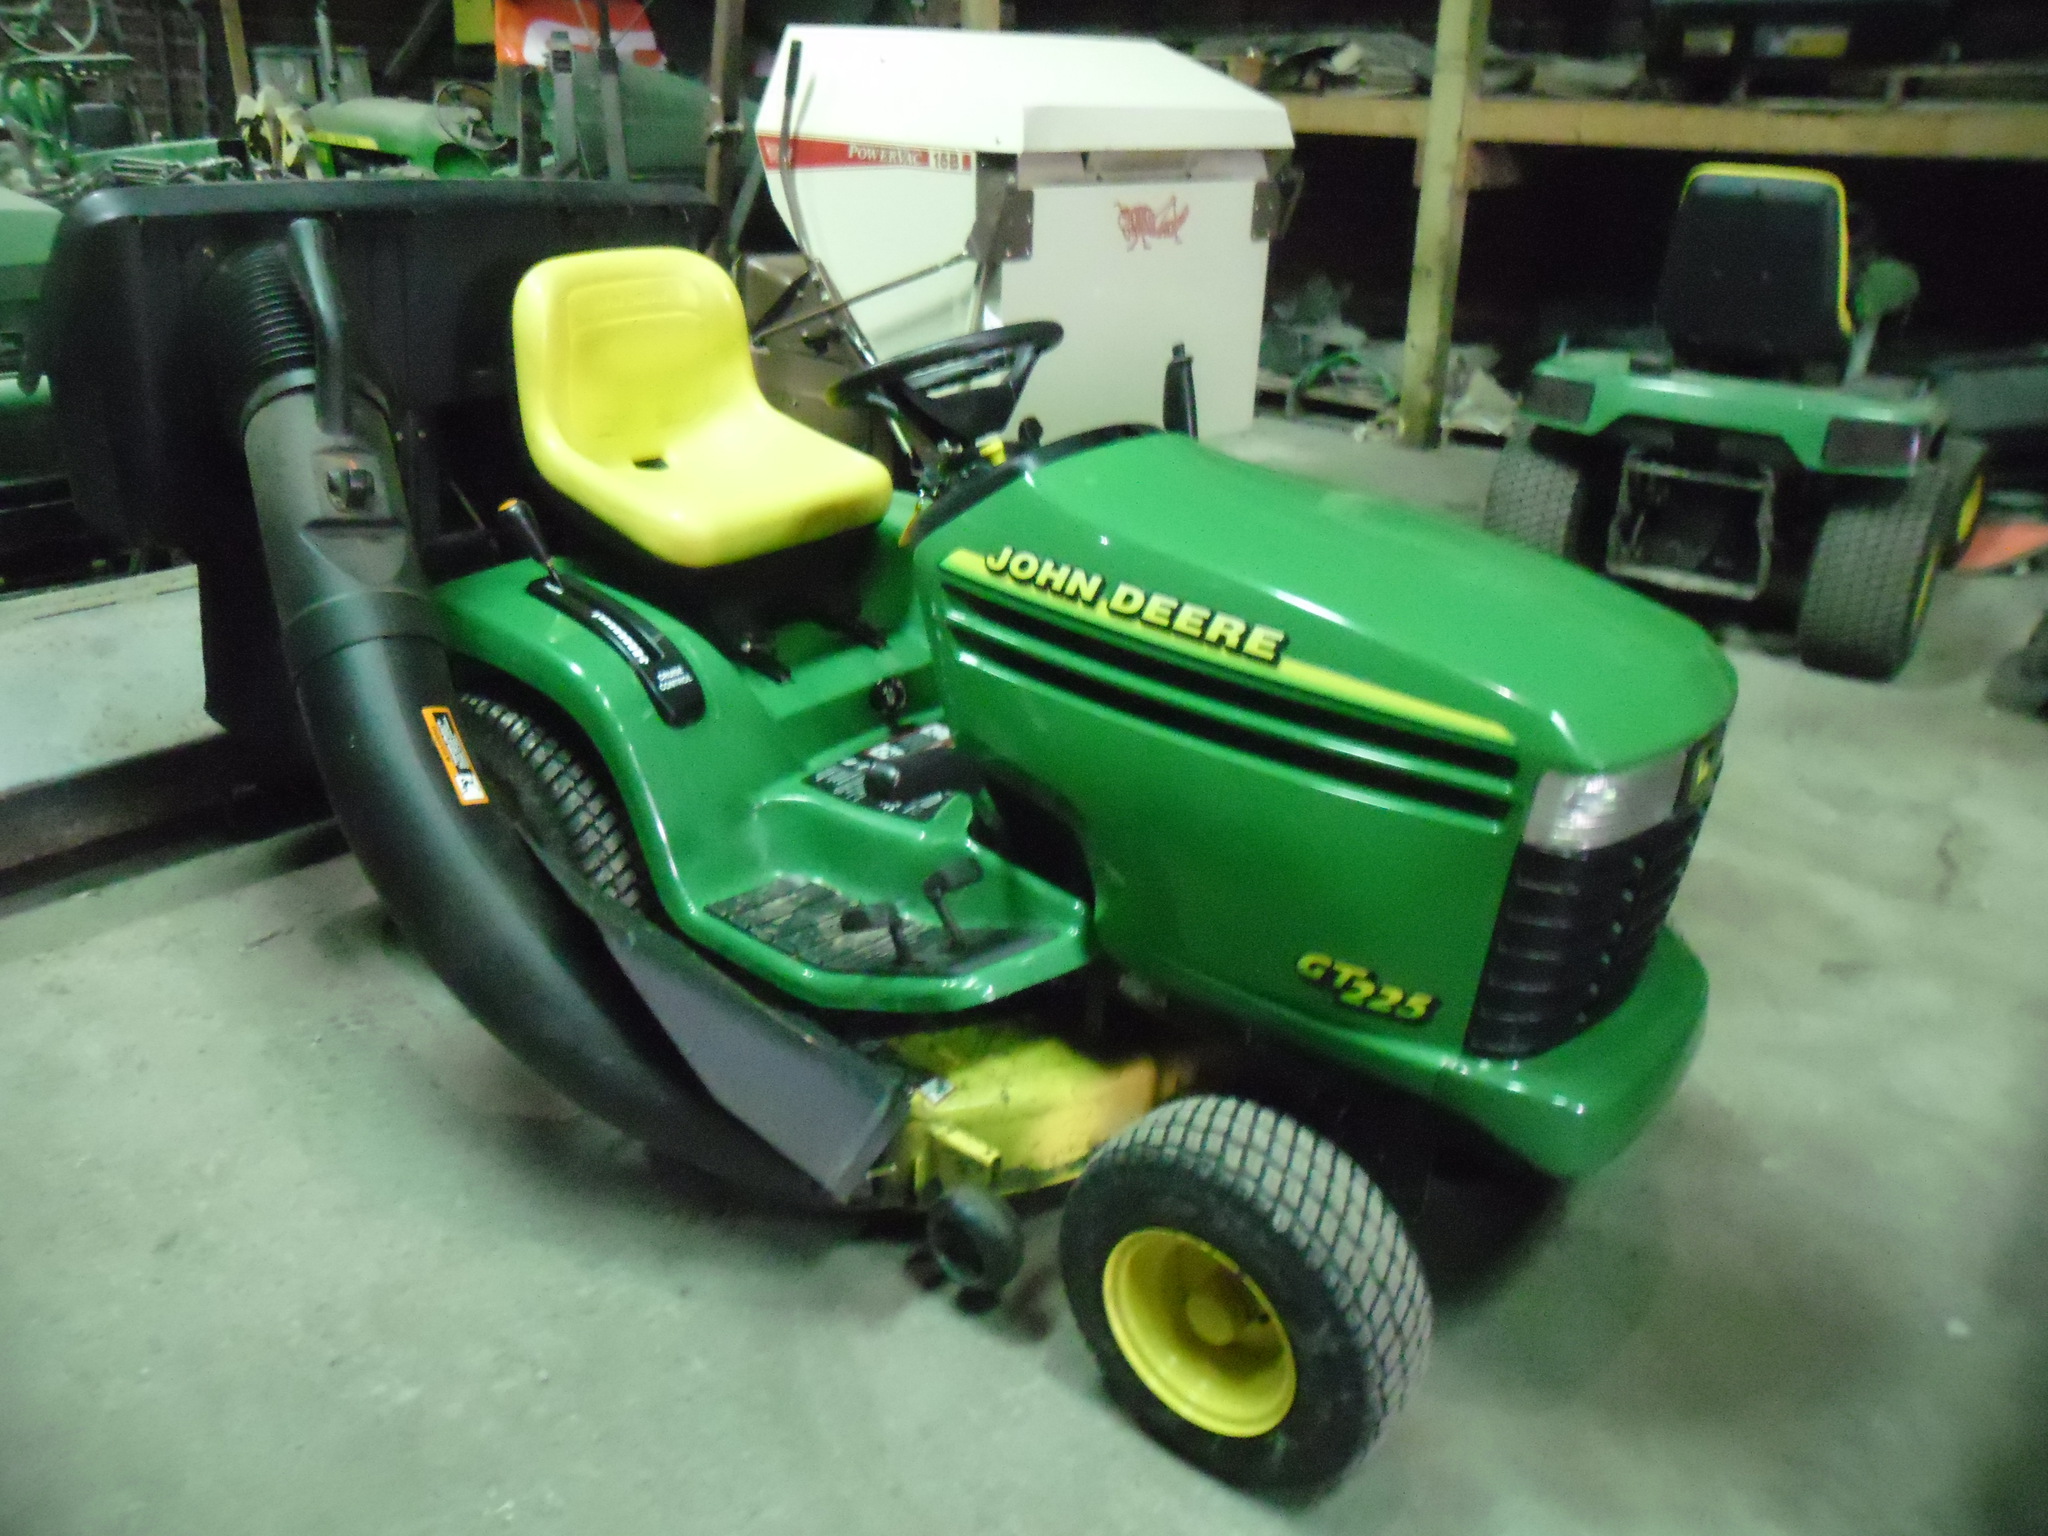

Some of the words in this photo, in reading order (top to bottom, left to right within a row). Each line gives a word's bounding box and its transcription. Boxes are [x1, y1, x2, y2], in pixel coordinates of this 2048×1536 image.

[986, 546, 1103, 604] JOHN
[1109, 582, 1287, 664] DEERE
[1296, 952, 1437, 1021] GT225
